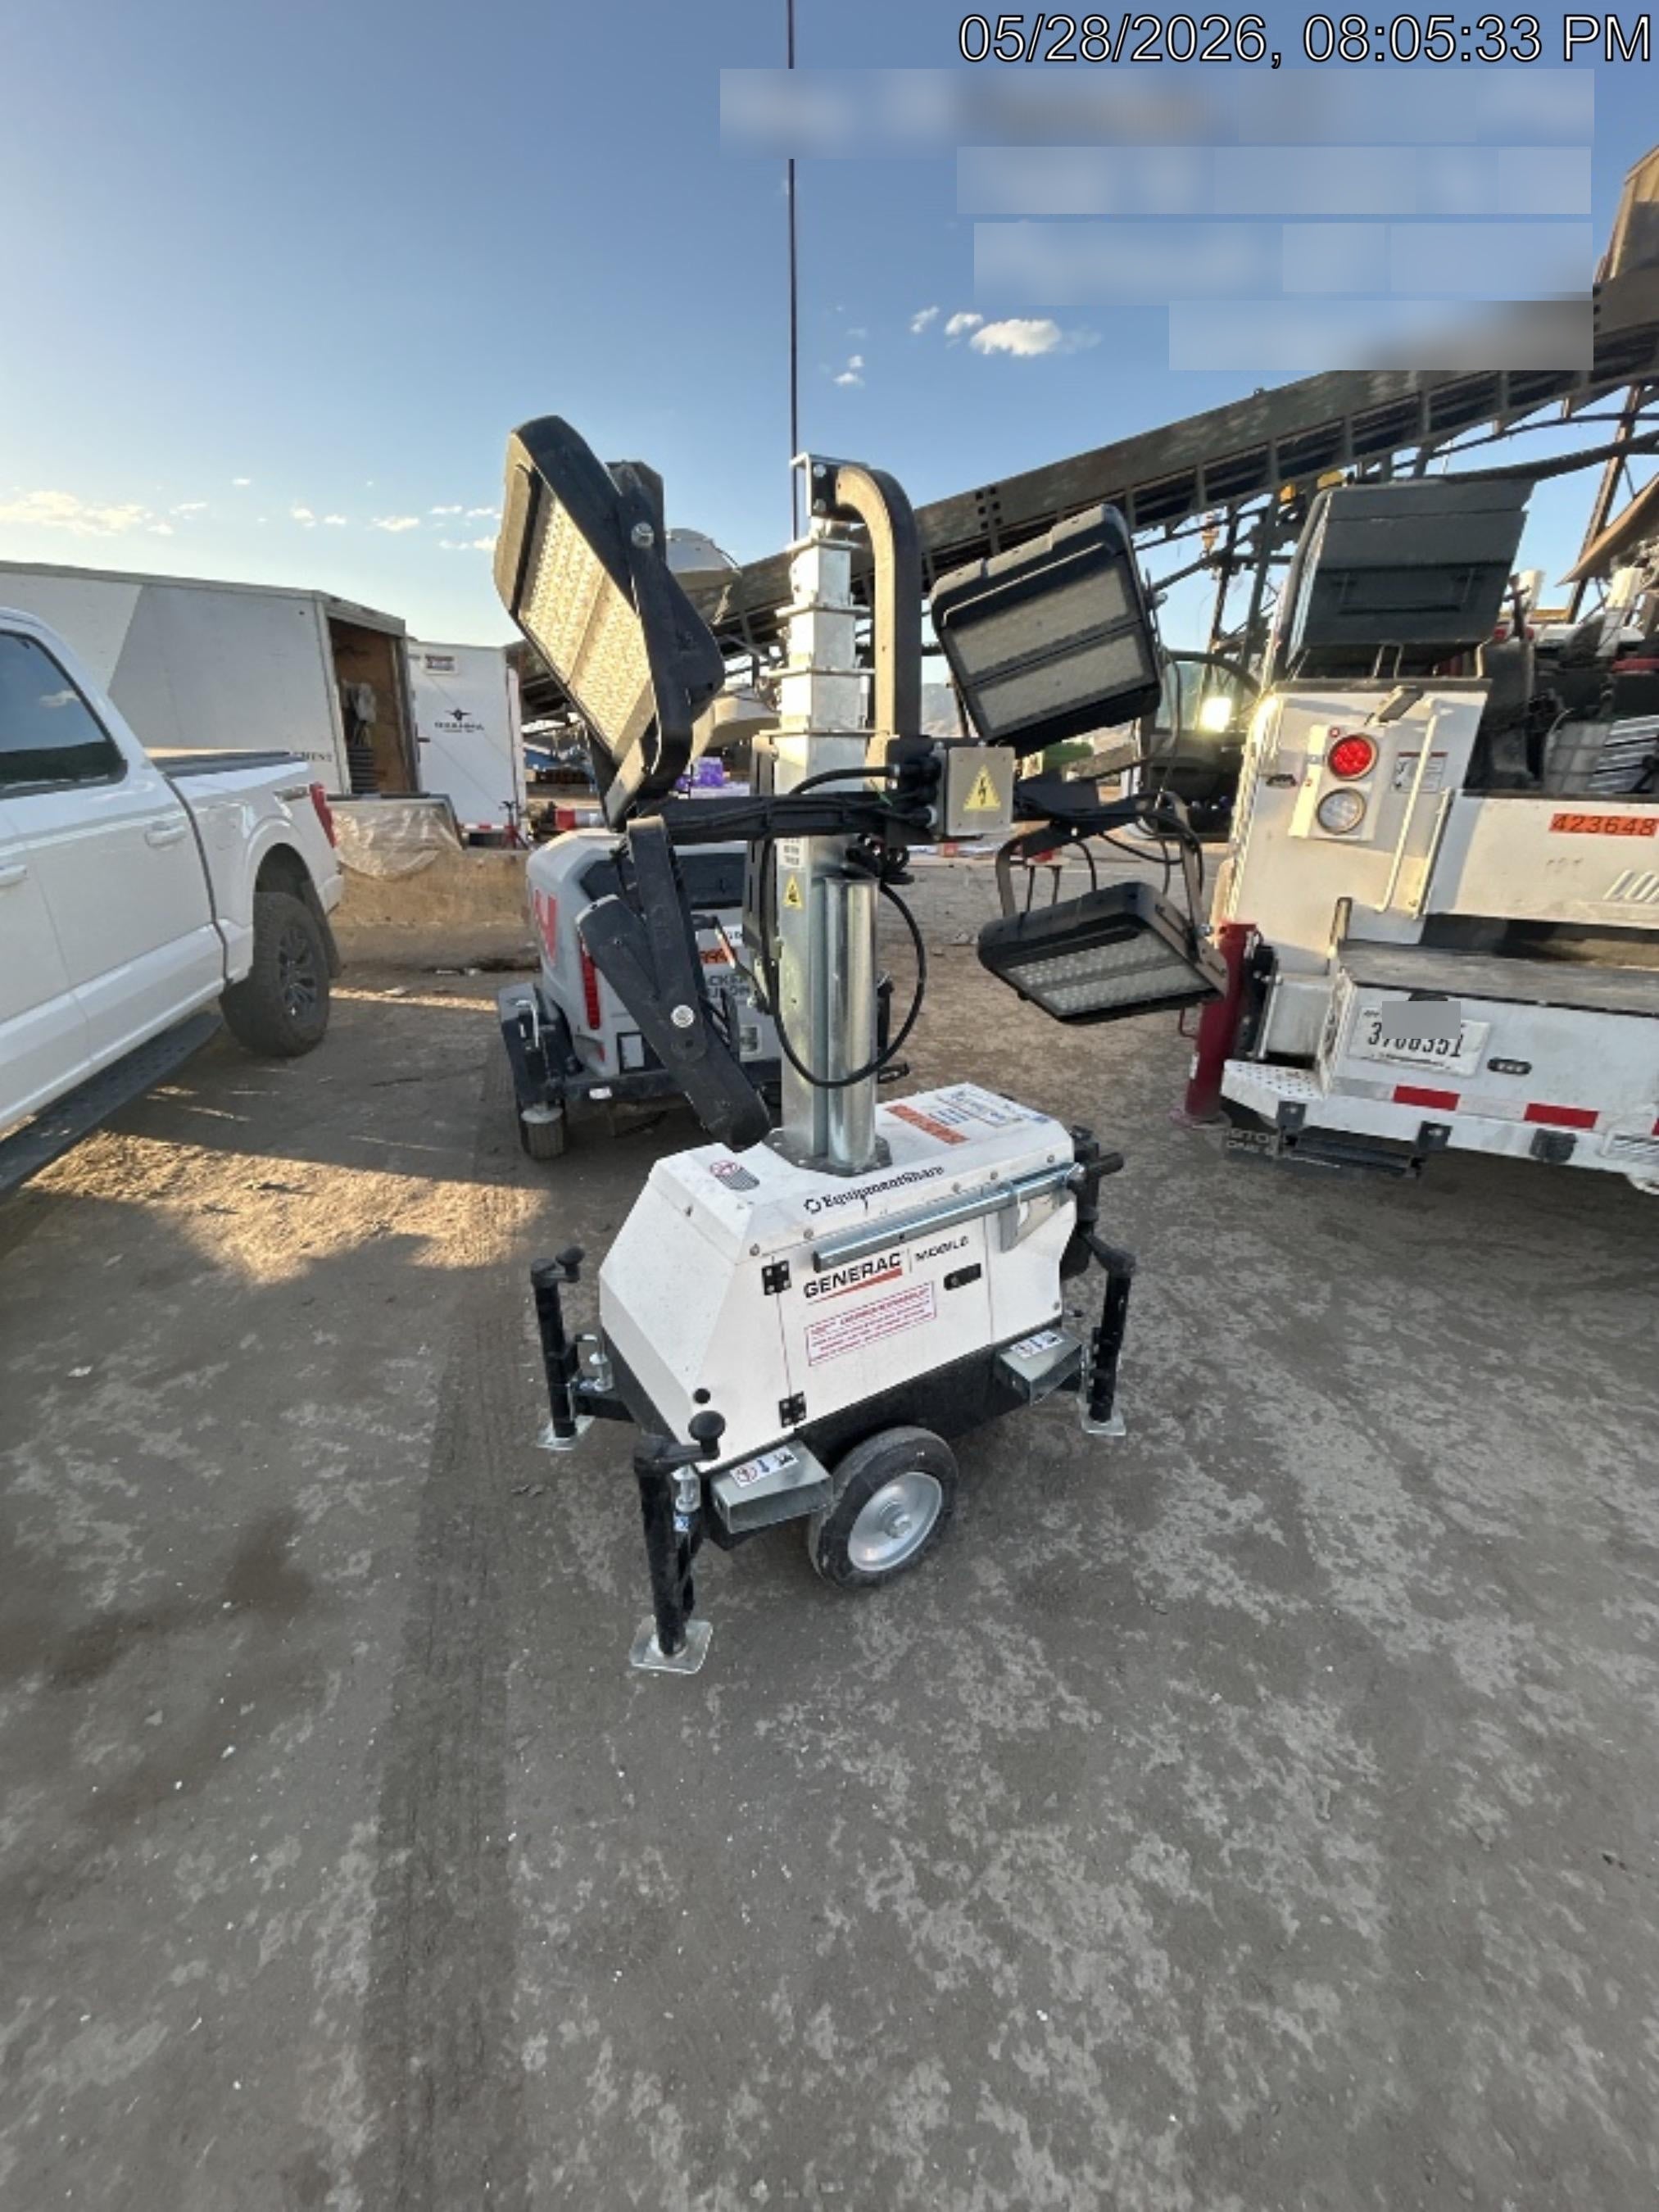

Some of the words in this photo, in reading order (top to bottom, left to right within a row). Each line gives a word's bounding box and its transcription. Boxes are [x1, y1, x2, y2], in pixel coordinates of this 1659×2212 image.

[1551, 815, 1656, 836] 423648
[822, 1166, 944, 1209] EquipmentShare
[804, 1253, 901, 1298] GENERAC
